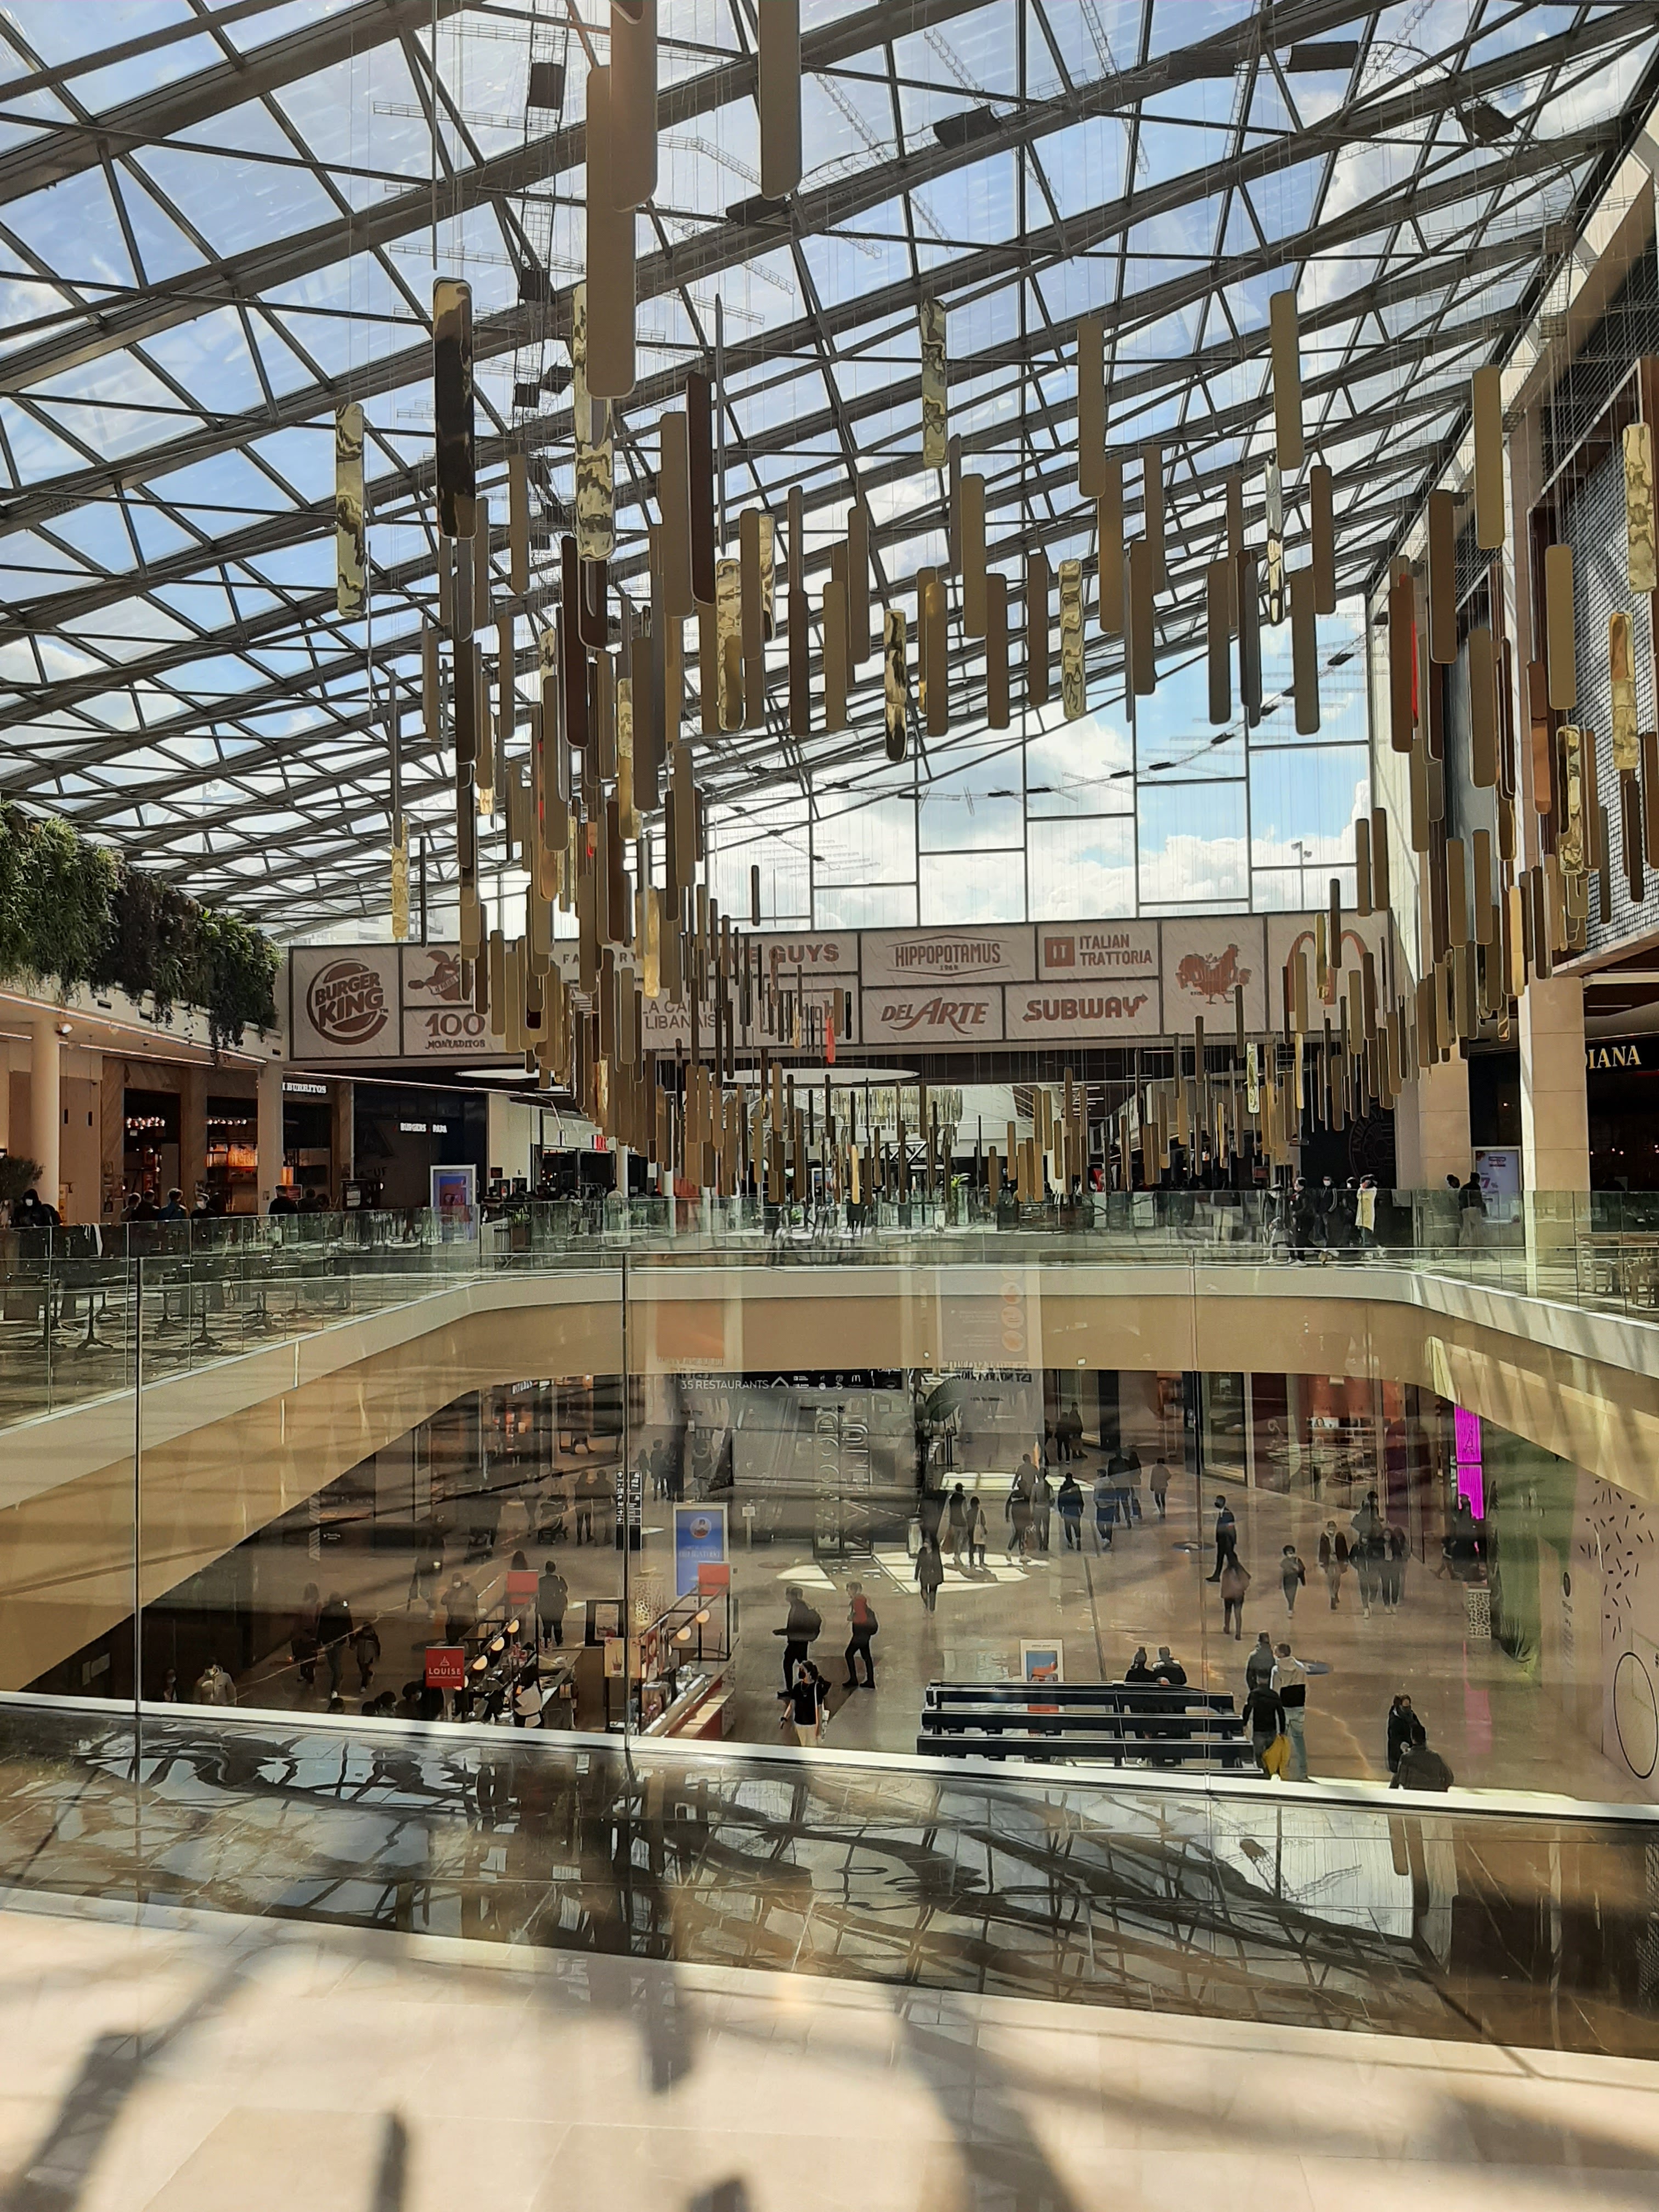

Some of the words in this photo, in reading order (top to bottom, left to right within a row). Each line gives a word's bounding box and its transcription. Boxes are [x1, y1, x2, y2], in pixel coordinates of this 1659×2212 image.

[1079, 934, 1130, 949] ITALIAN
[769, 943, 840, 963] GUYS
[895, 943, 1001, 967] HIPPOPOTAMUS
[1052, 945, 1067, 959] IT
[1079, 950, 1153, 966] TRATTORIA
[315, 972, 380, 1007] BURGER
[318, 987, 383, 1030] KING
[881, 1003, 913, 1022] DEL
[888, 996, 990, 1035] ARTE
[1022, 993, 1149, 1023] SUBWAY
[425, 1013, 486, 1037] 100
[425, 1039, 486, 1050] MONTADITOS
[1585, 1045, 1642, 1070] IANA
[286, 1082, 327, 1093] BURRITOS
[681, 1380, 694, 1390] 35
[695, 1379, 769, 1390] RESTAURANTS
[428, 1667, 461, 1675] LOUISE
